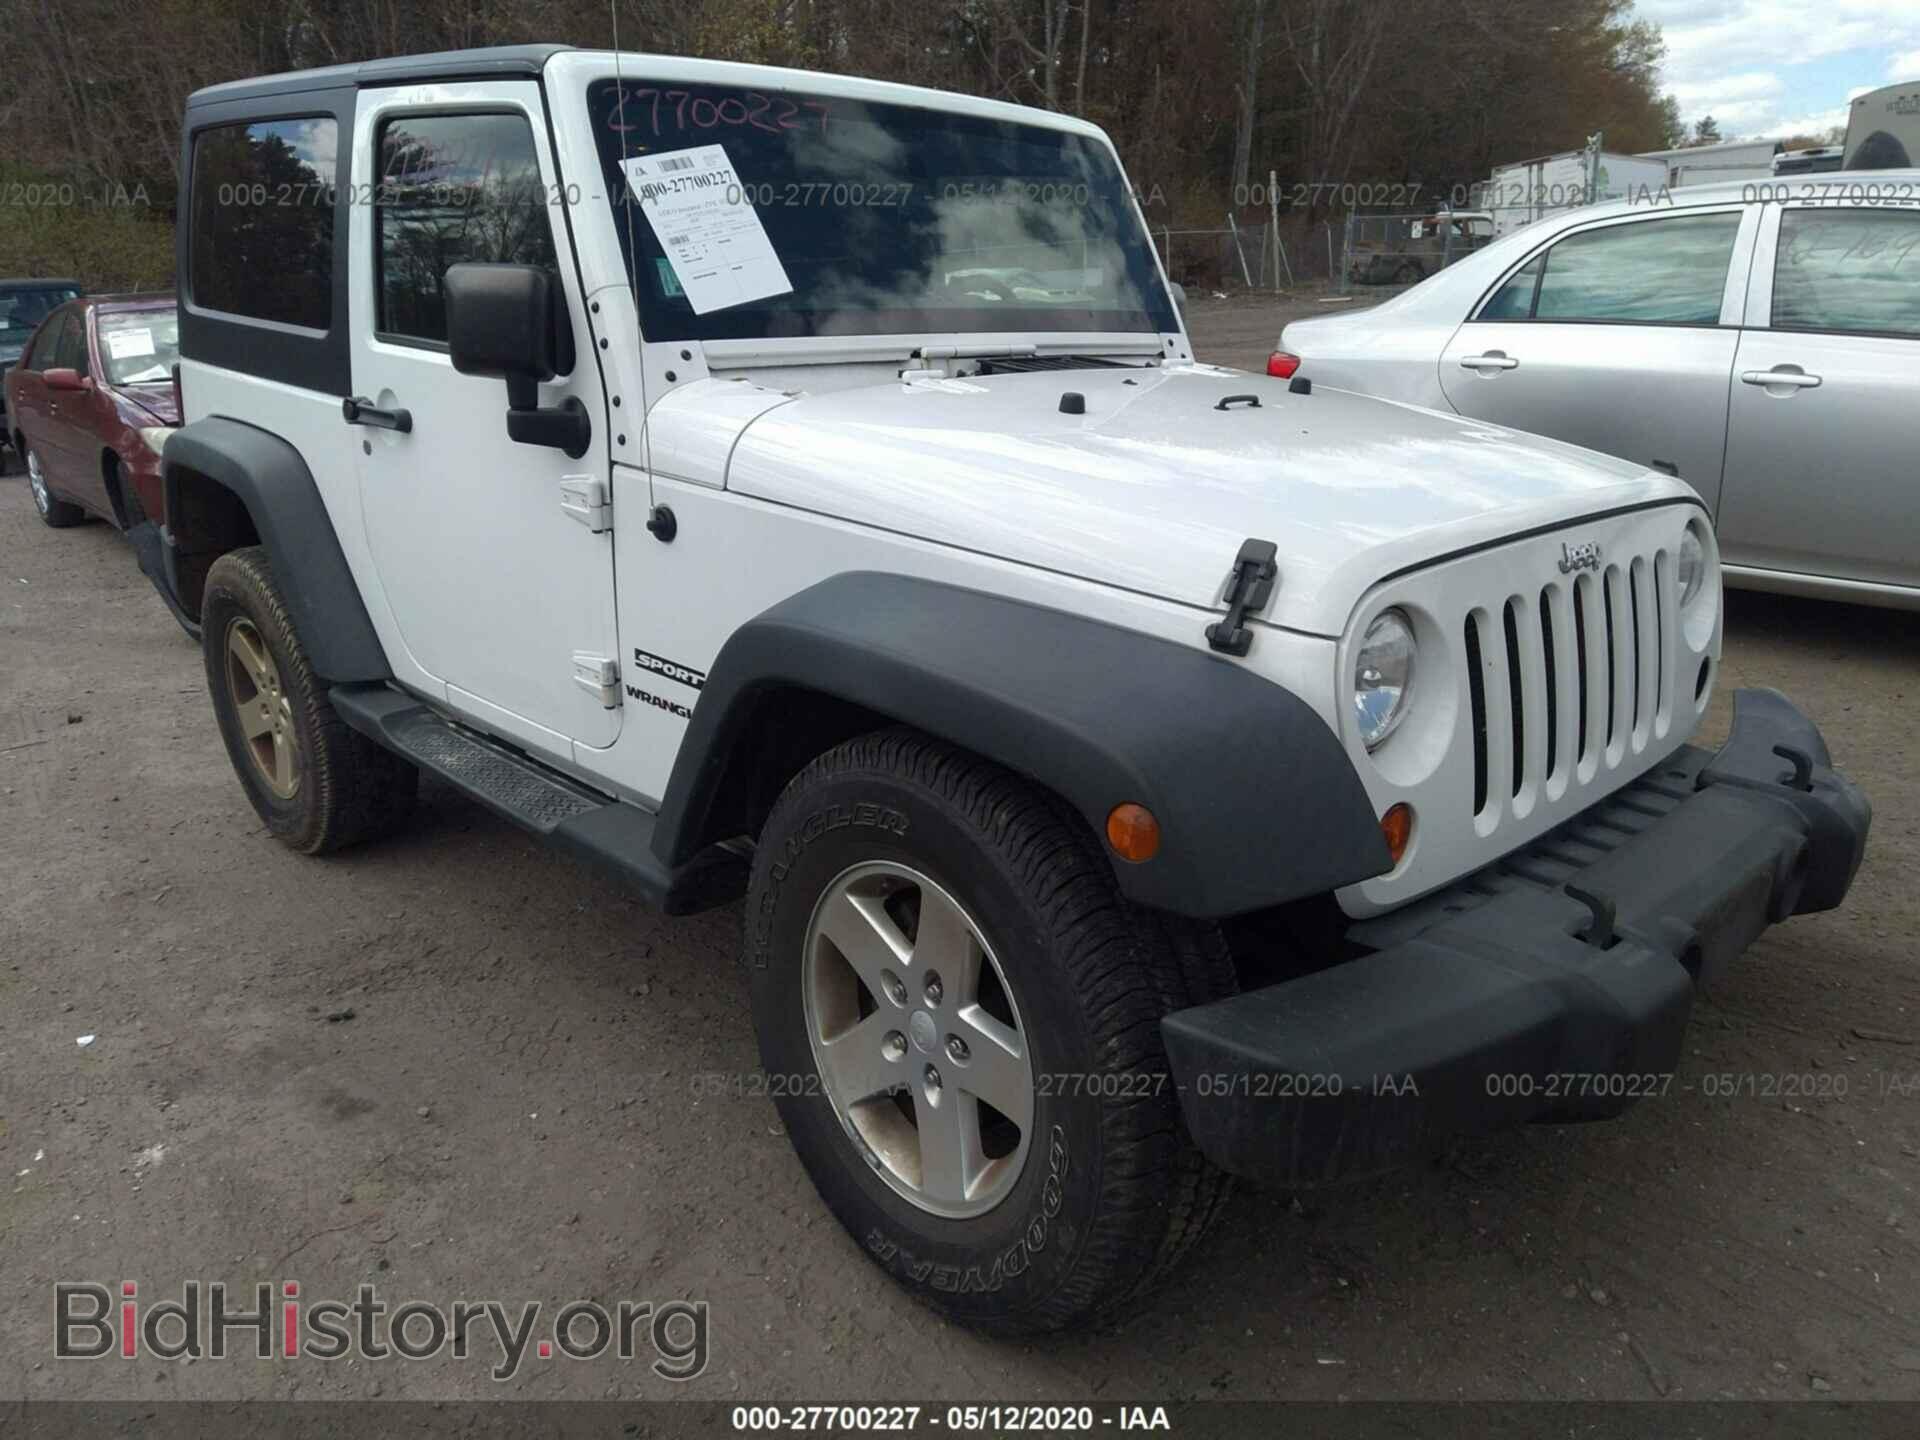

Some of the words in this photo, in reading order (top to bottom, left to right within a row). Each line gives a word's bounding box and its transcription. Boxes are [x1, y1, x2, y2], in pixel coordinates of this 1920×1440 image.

[602, 86, 832, 136] 27700227
[640, 170, 734, 198] 000-27700227
[1558, 542, 1602, 573] Jeep
[637, 653, 707, 686] SPORT
[864, 1123, 1070, 1294] GOODYEAR
